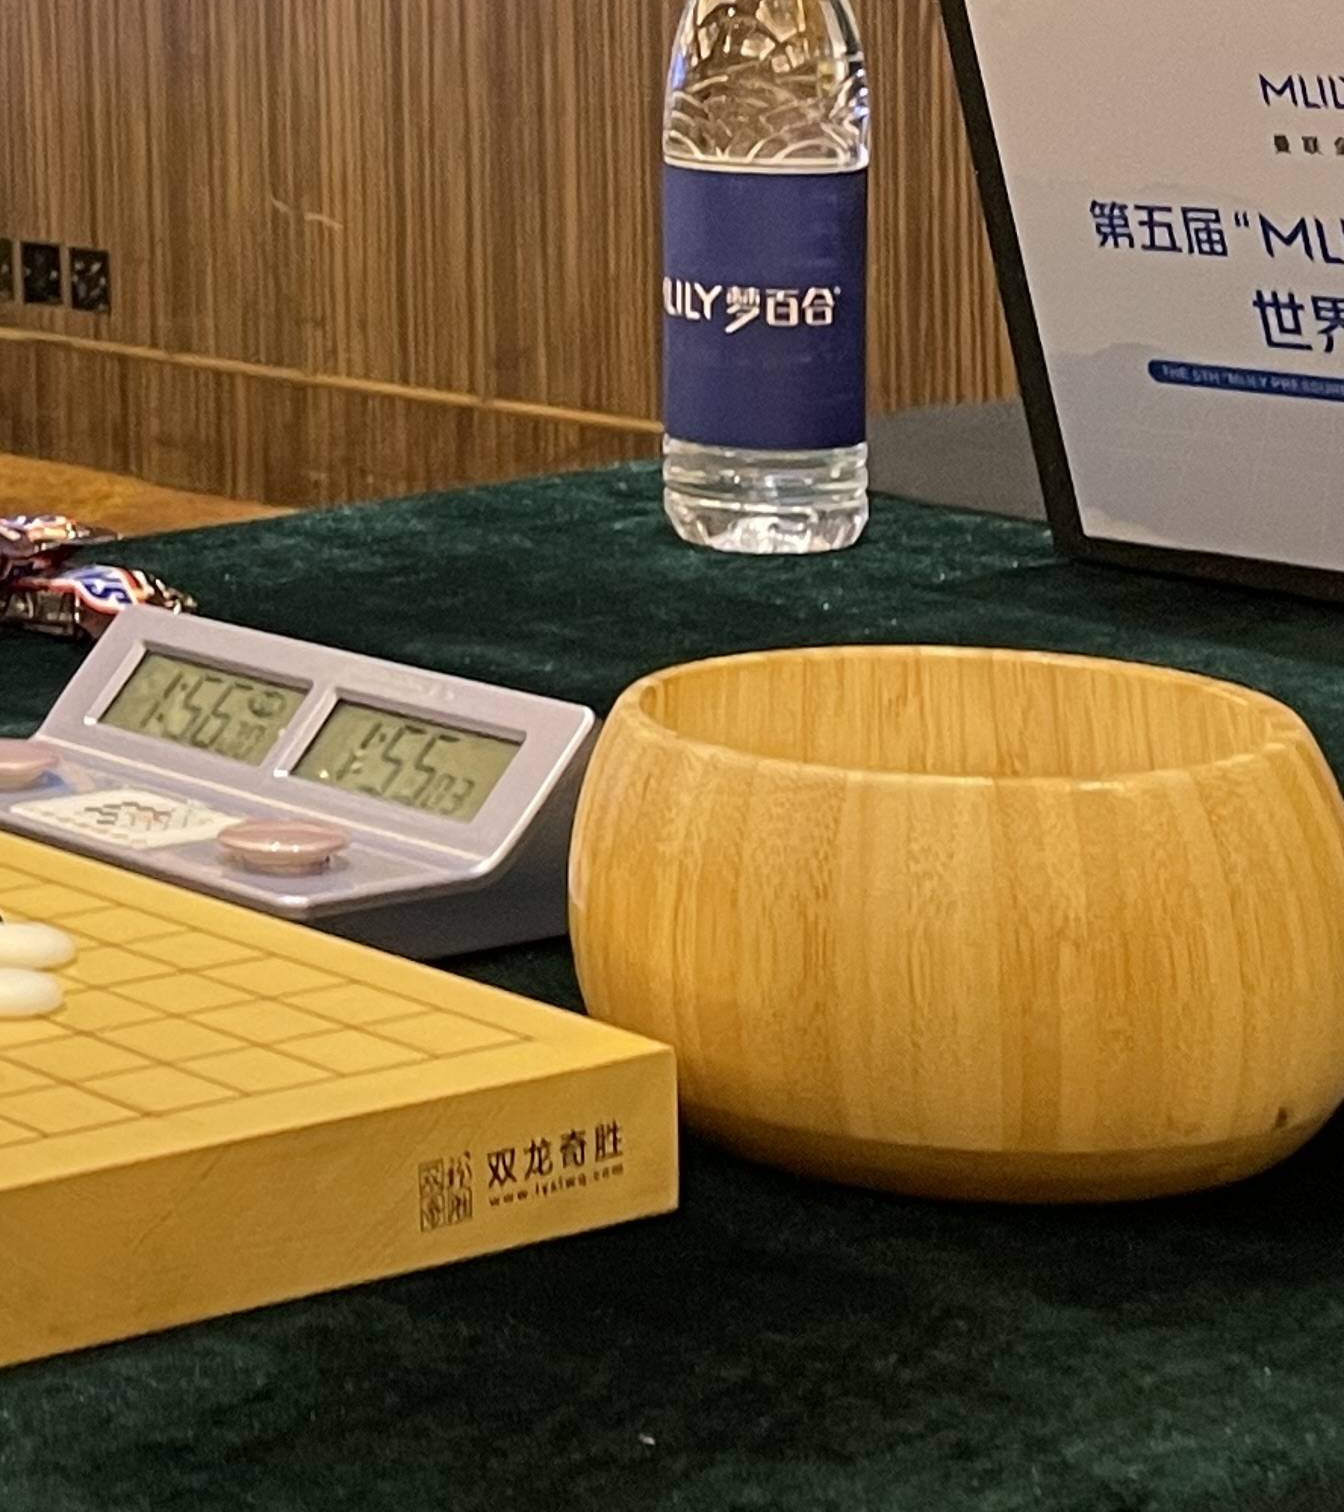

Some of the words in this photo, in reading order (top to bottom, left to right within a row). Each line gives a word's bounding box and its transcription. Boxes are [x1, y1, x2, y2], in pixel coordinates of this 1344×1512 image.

[1258, 73, 1344, 110] MLIL
[1090, 199, 1344, 265] 第五届“ML
[336, 722, 461, 805] 1:55
[486, 1119, 624, 1189] 双龙奇胜
